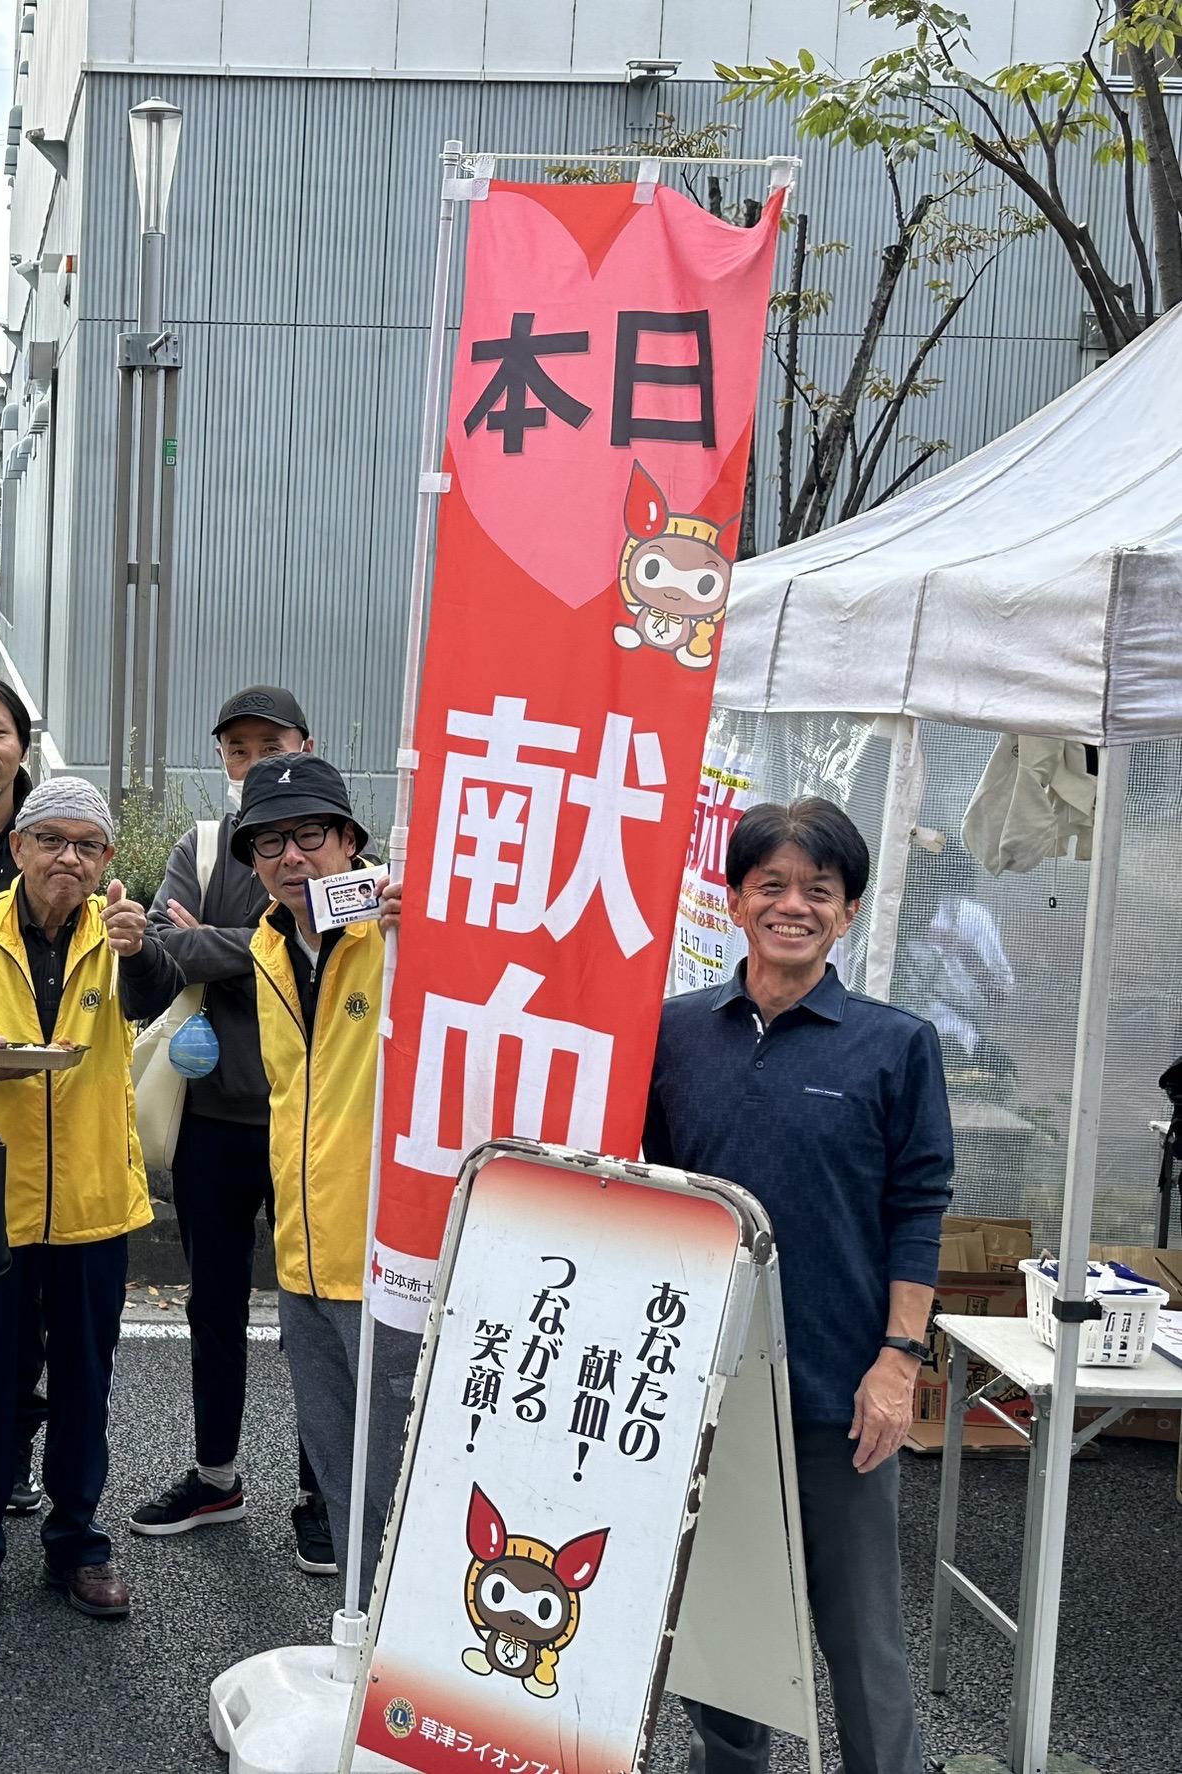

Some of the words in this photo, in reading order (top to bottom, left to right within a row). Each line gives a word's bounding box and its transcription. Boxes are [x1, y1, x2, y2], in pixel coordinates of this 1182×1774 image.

[464, 309, 717, 454] 本日
[393, 695, 667, 1178] 献血
[461, 1319, 513, 1453] 笑顔！
[512, 1256, 577, 1423] つながる
[568, 1345, 622, 1482] 献血！
[618, 1282, 690, 1462] あなたの
